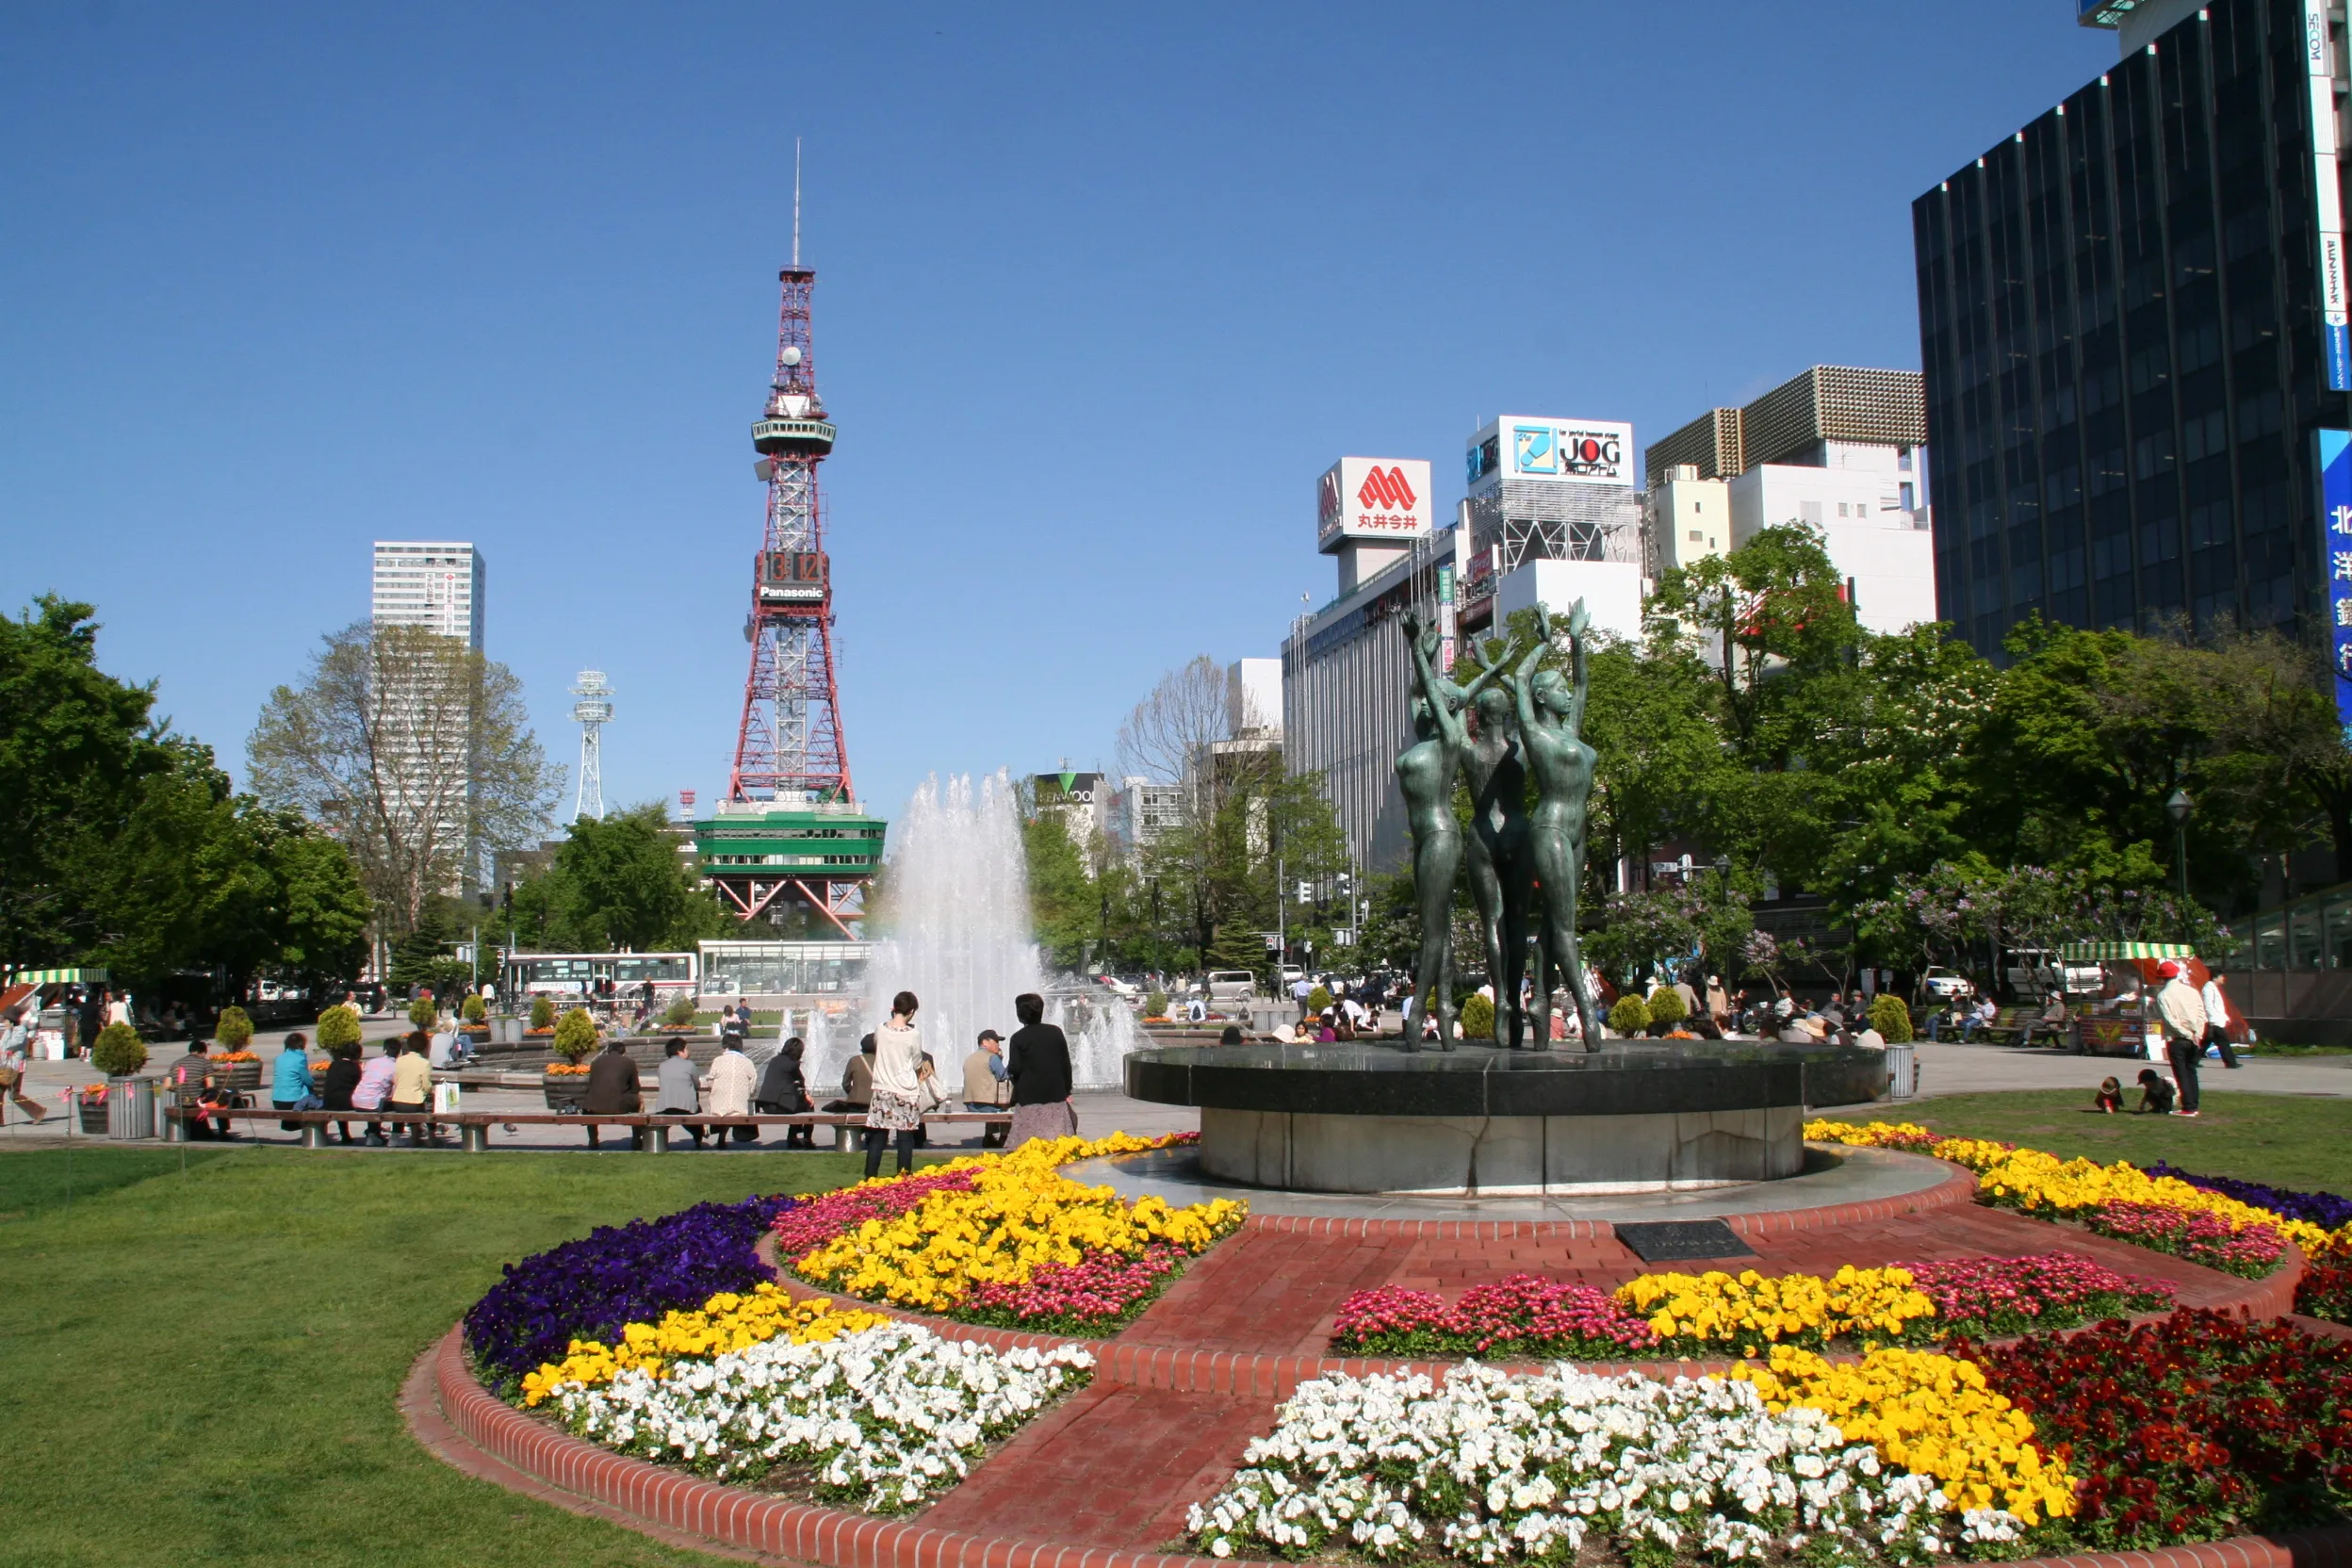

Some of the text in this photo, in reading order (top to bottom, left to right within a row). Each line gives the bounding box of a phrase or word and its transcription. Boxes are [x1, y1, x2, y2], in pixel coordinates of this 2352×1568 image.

[2308, 13, 2321, 60] SECOM
[1560, 438, 1620, 464] JOG
[1357, 514, 1417, 530] 丸井今井
[760, 587, 823, 597] Panasonic
